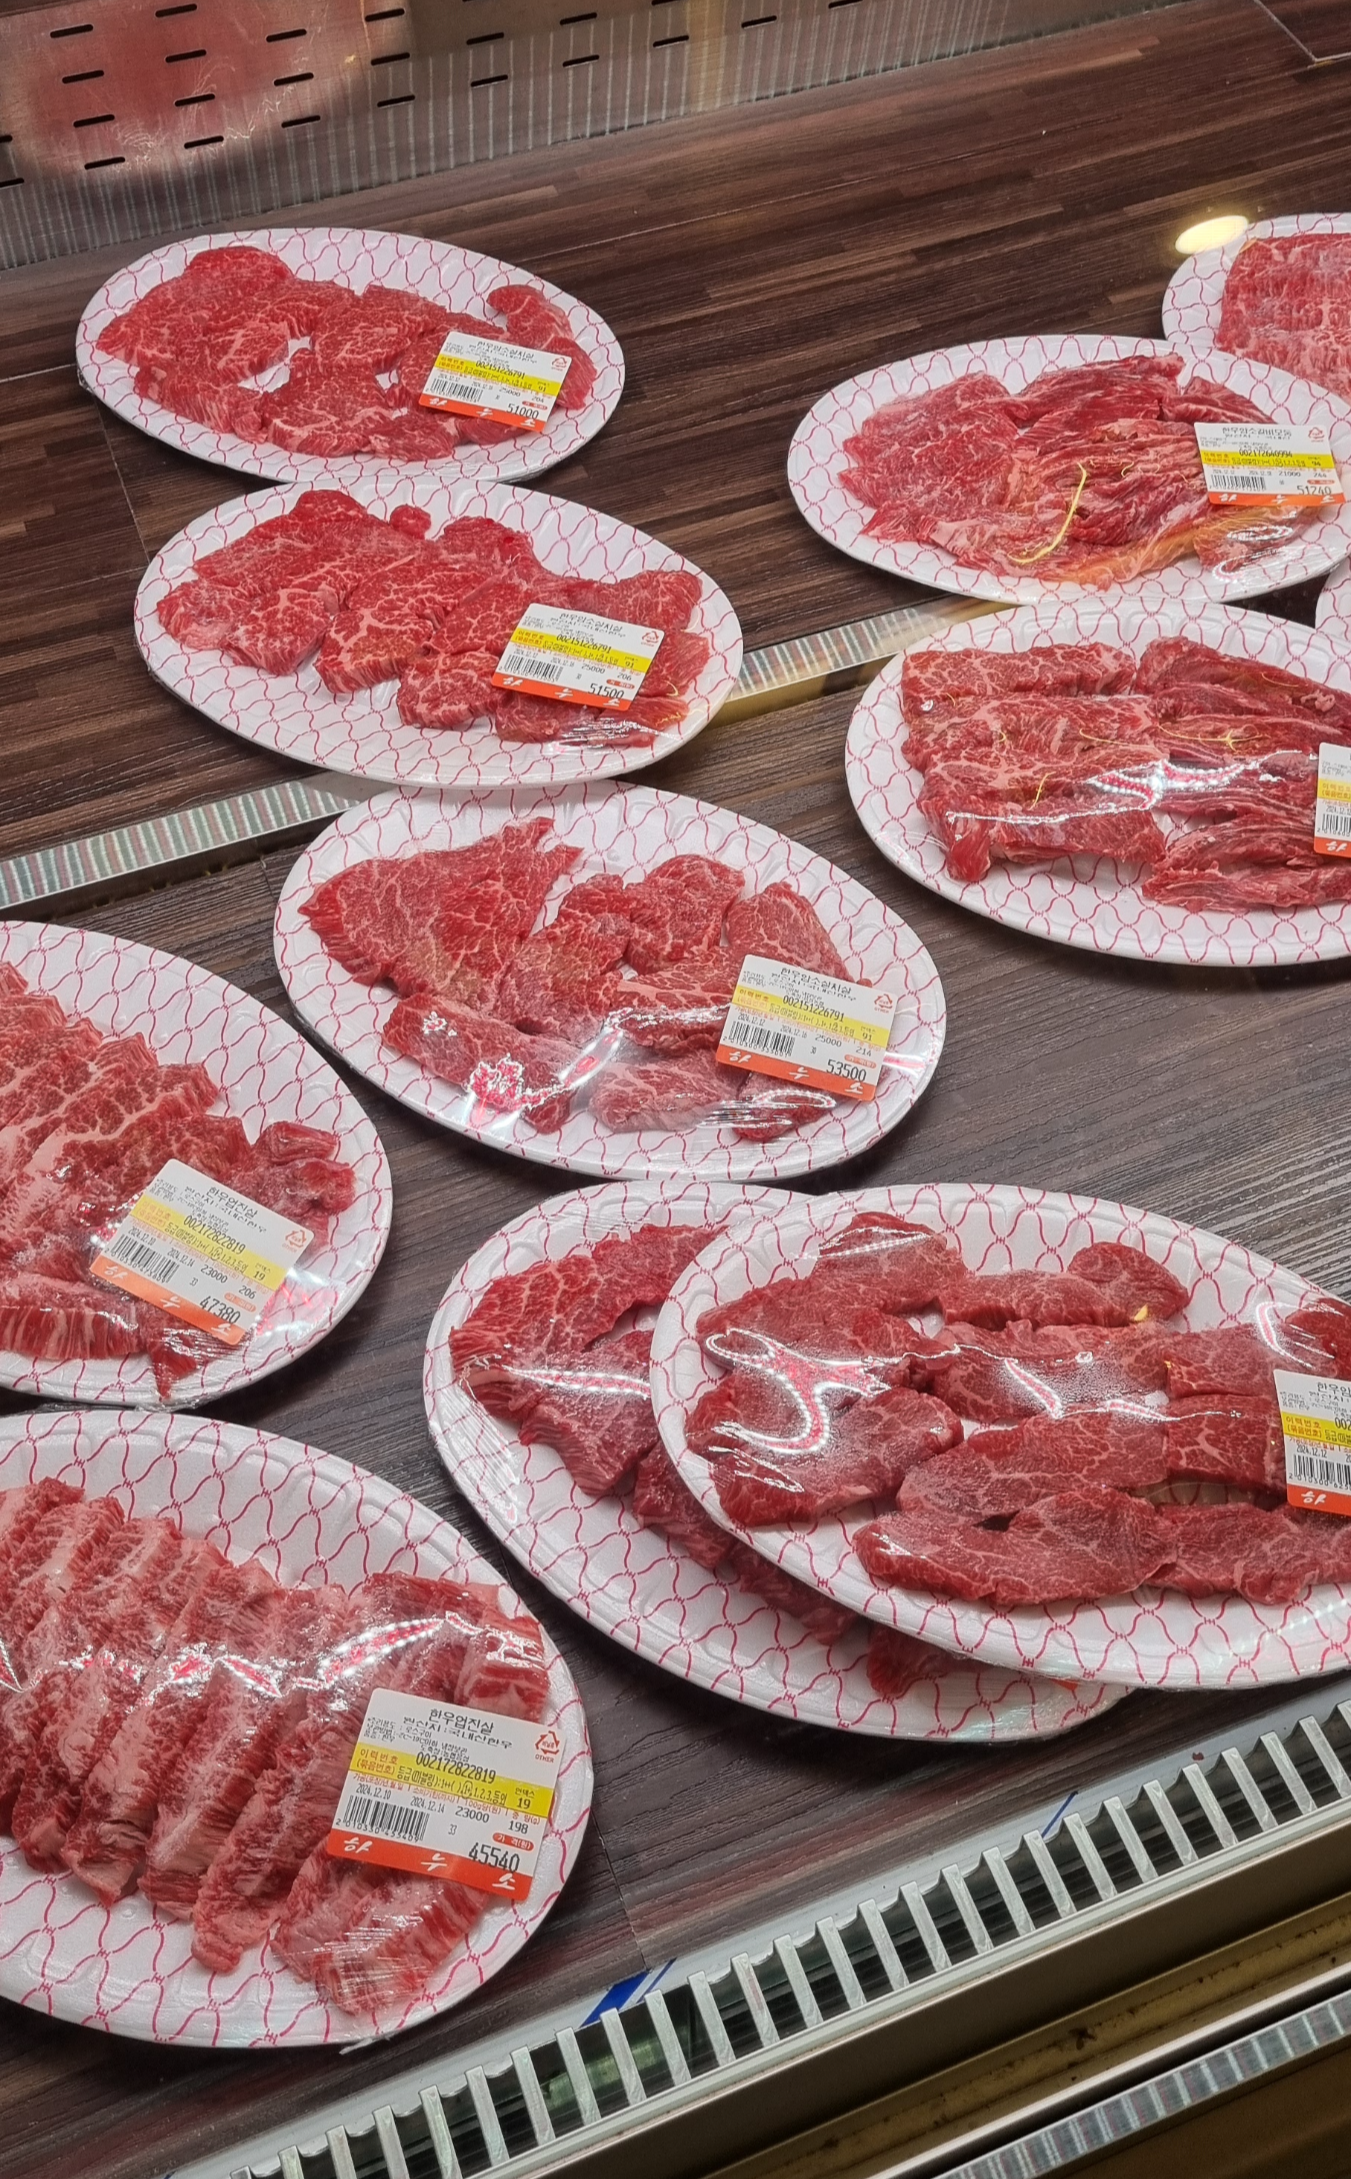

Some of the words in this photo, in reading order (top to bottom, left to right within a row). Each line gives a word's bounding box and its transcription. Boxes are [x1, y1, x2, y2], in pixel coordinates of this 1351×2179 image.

[498, 386, 521, 396] 25000
[505, 403, 539, 419] 51000
[1296, 484, 1331, 495] 51240
[554, 633, 612, 653] 002151226791
[580, 663, 606, 674] 25000
[616, 672, 632, 680] 206
[587, 682, 625, 699] 51500
[782, 995, 845, 1021] 002151226791
[737, 1013, 765, 1026] 2024.12.12
[780, 1024, 808, 1038] 2024.12.16
[815, 1034, 842, 1047] 25000
[856, 1046, 872, 1056] 214
[861, 1032, 872, 1040] 91
[825, 1059, 867, 1082] 53500
[206, 1186, 258, 1218] 한우업진살
[182, 1215, 246, 1254] 002172822819
[128, 1227, 156, 1245] 2024.12.10
[167, 1248, 195, 1267] 2024.12.14
[200, 1264, 228, 1283] 23000
[238, 1285, 256, 1299] 206
[189, 1277, 198, 1286] 33
[253, 1270, 265, 1281] 19
[199, 1295, 241, 1324] 47380
[1297, 1444, 1327, 1458] 2024.12.12
[428, 1708, 494, 1734] 한우업진살
[414, 1752, 496, 1783] 002172822819
[356, 1783, 391, 1799] 2024.12.10
[410, 1796, 445, 1813] 2024.12.14
[455, 1806, 489, 1822] 23000
[508, 1820, 528, 1834] 198
[517, 1797, 530, 1809] 19
[448, 1824, 457, 1835] 33
[468, 1842, 520, 1872] 45540
